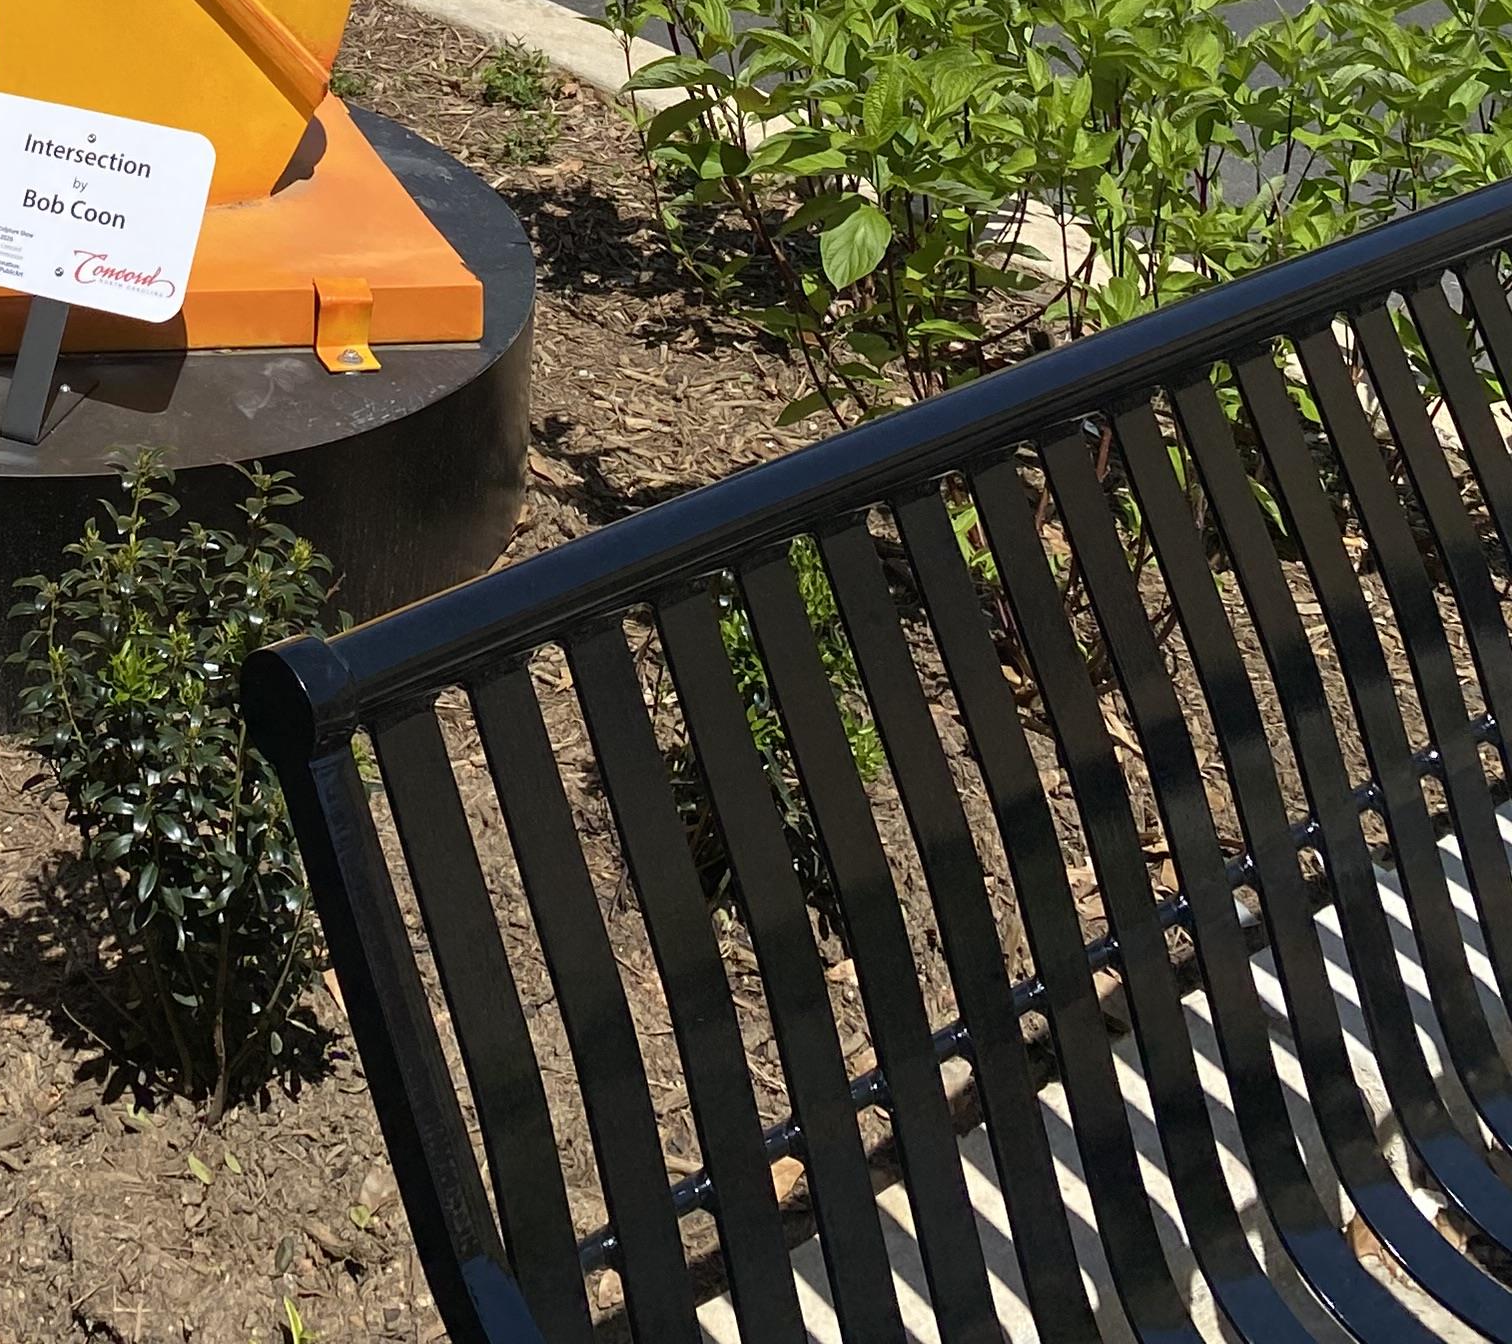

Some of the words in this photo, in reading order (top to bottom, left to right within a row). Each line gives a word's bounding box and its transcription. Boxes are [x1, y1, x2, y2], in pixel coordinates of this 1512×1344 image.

[24, 133, 151, 179] Intersection
[72, 176, 88, 192] by
[22, 189, 65, 215] Bob
[70, 200, 126, 230] Coon
[74, 250, 175, 298] Concord
